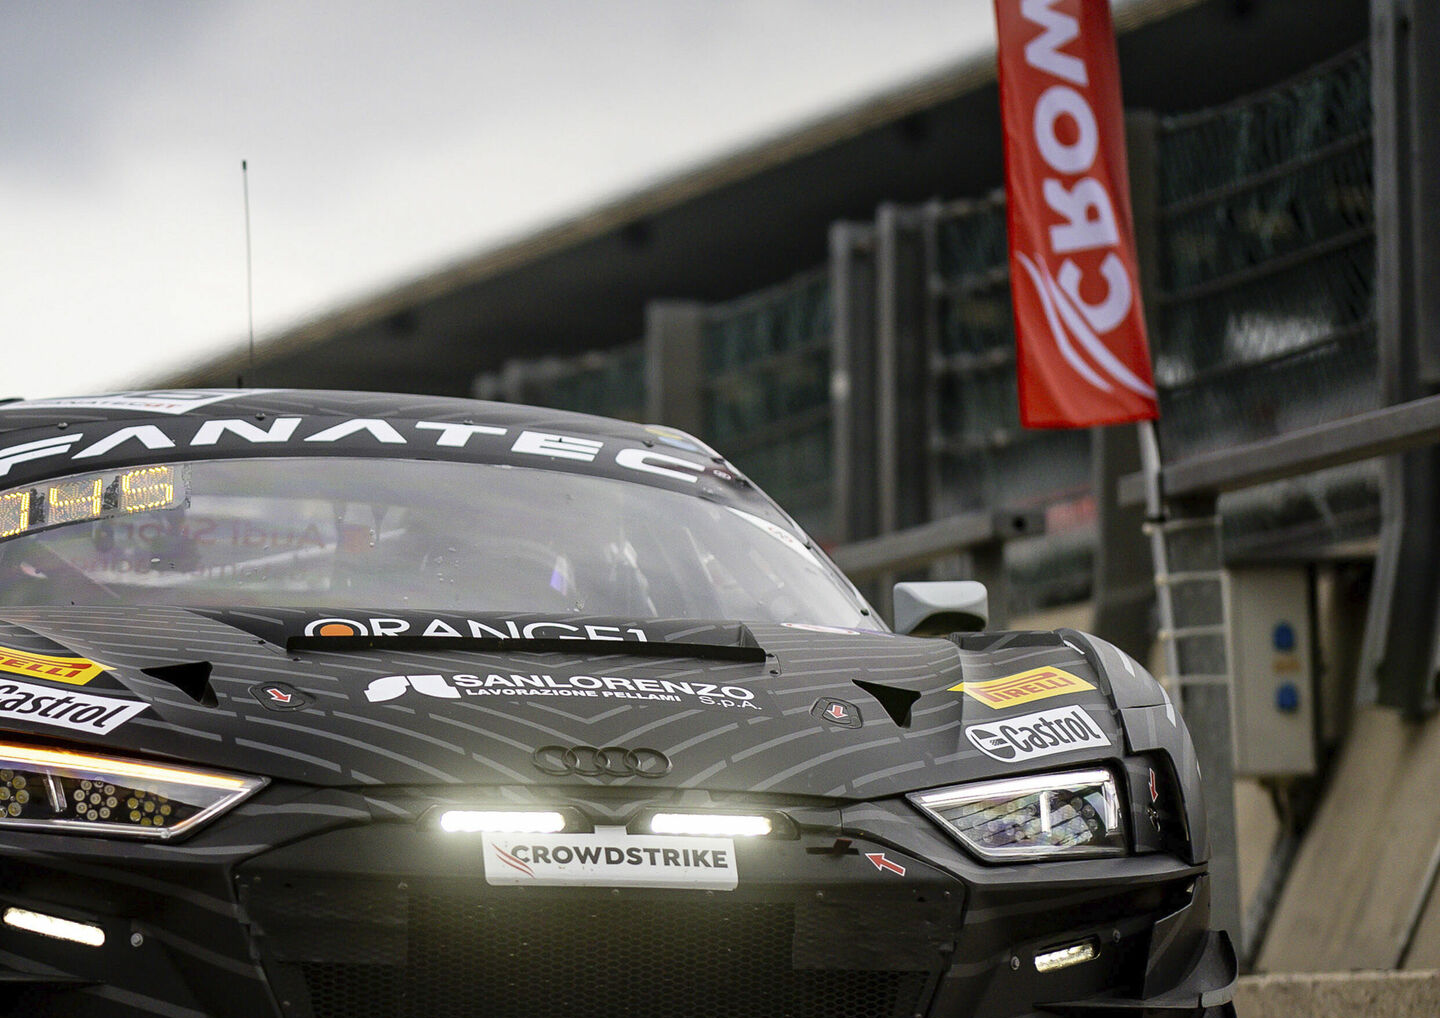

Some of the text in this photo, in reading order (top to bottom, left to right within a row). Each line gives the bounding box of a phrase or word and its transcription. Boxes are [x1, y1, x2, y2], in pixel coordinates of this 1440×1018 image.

[452, 674, 756, 701] SANLORENZO
[465, 688, 681, 703] LAVORAZIONE PELLAMI
[968, 671, 1076, 703] PIRELLI
[699, 694, 763, 711] S.p.A.
[999, 710, 1102, 753] Castrol
[510, 844, 729, 869] CROWDSTRIKE
